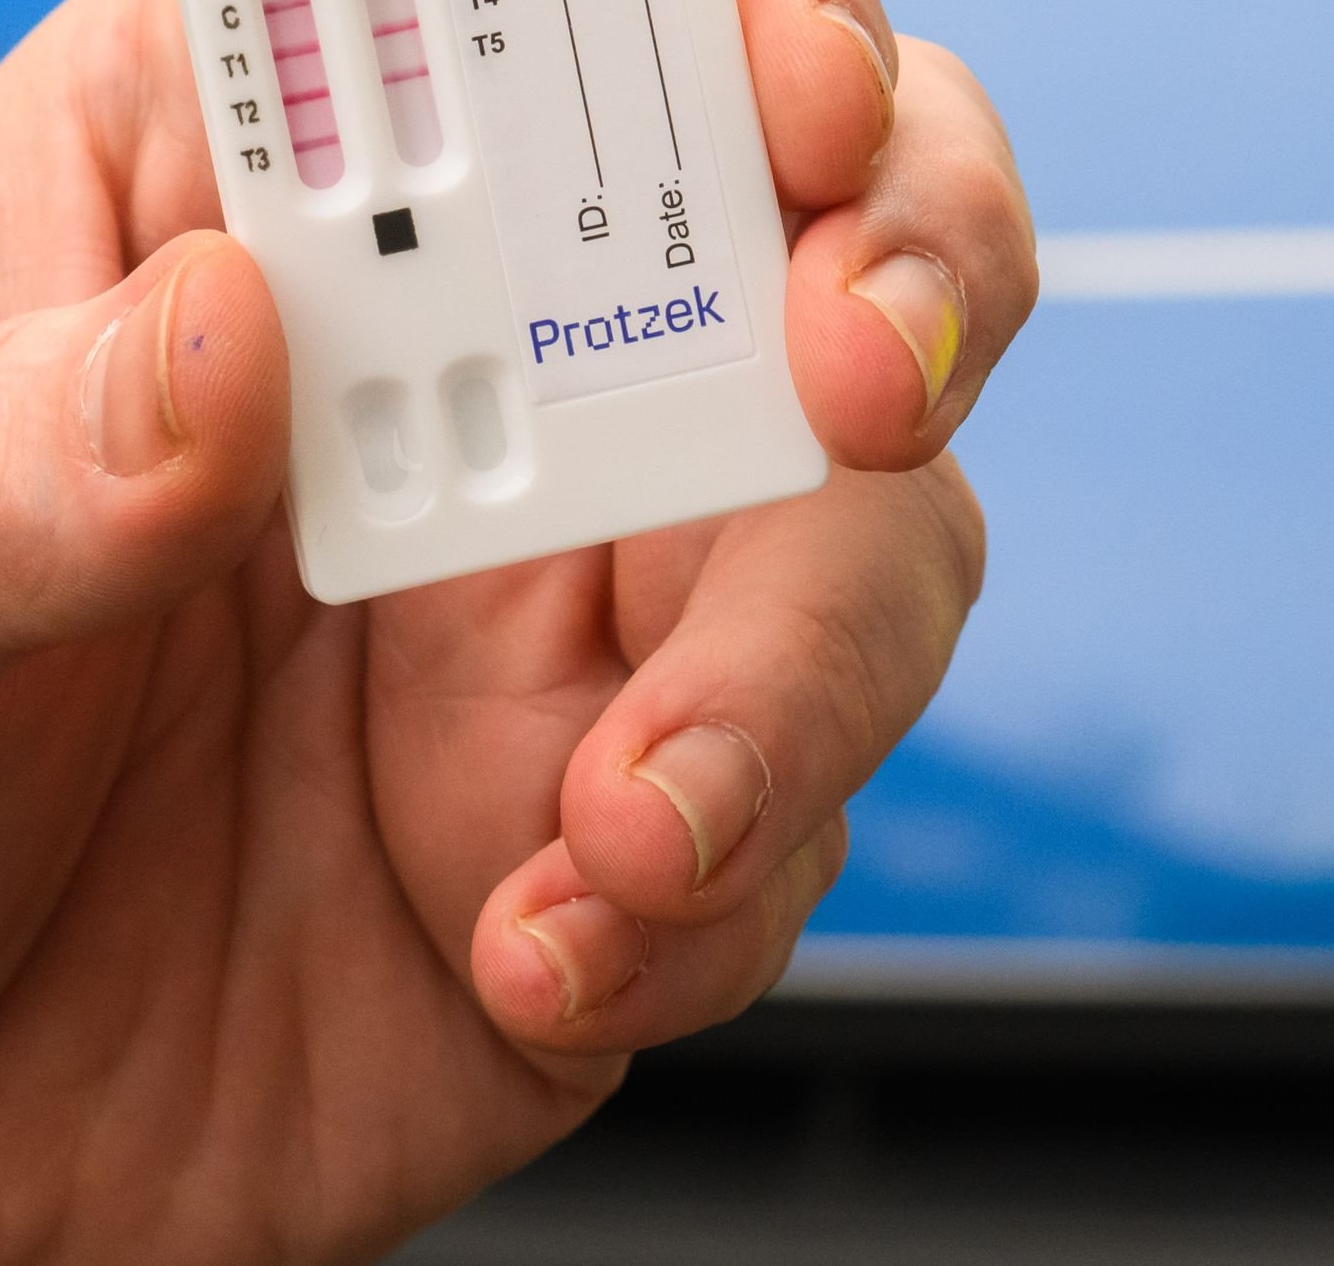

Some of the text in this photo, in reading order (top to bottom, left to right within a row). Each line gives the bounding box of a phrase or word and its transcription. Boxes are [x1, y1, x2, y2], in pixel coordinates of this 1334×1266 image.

[220, 5, 241, 30] C
[471, 31, 506, 56] T5
[220, 53, 249, 78] T1
[230, 99, 260, 125] T2
[240, 147, 271, 172] T3
[577, 194, 610, 242] ID:
[658, 179, 695, 269] Date:
[529, 285, 725, 364] Protzek
